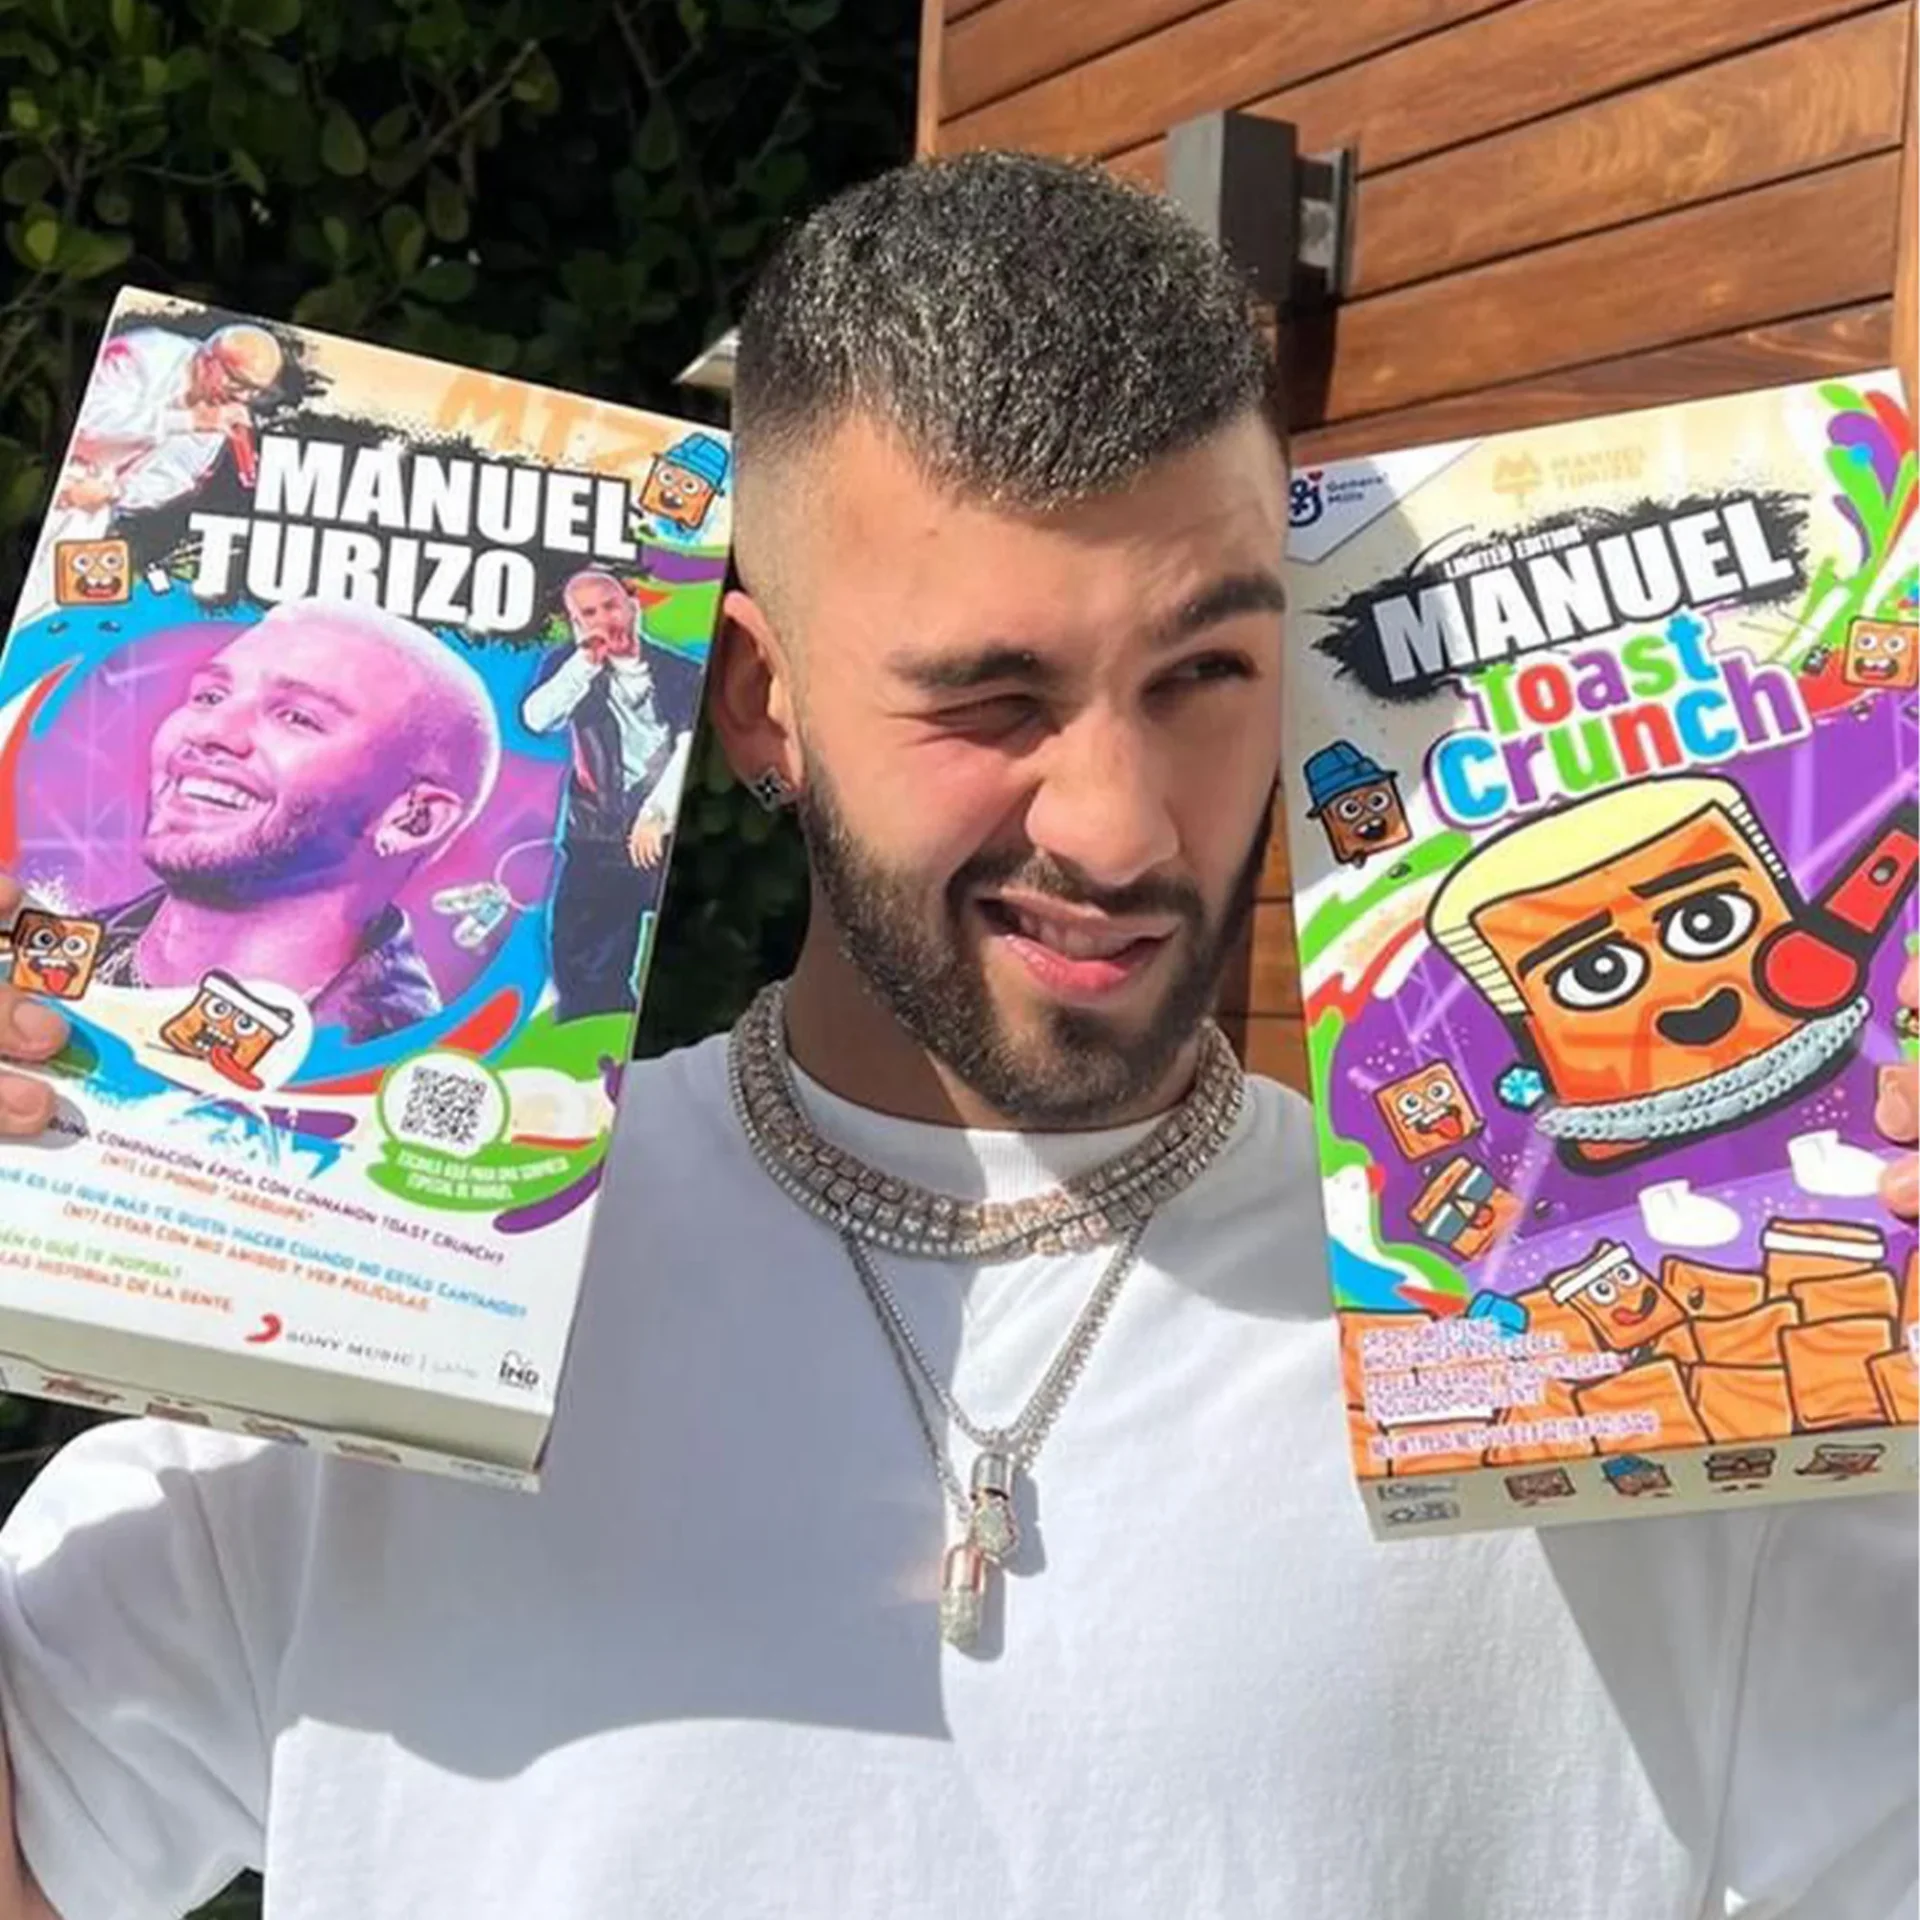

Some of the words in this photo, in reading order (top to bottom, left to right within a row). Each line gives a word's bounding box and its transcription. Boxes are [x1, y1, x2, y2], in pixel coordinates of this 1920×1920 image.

[253, 434, 636, 560] MANUEL
[189, 512, 536, 633] TURIZO
[1372, 500, 1795, 684] MANUEL
[1434, 655, 1803, 820] Crunch
[258, 1176, 291, 1197] CON
[294, 1187, 377, 1224] CINNAMON
[382, 1214, 430, 1240] TOAST
[286, 1331, 342, 1351] SONY
